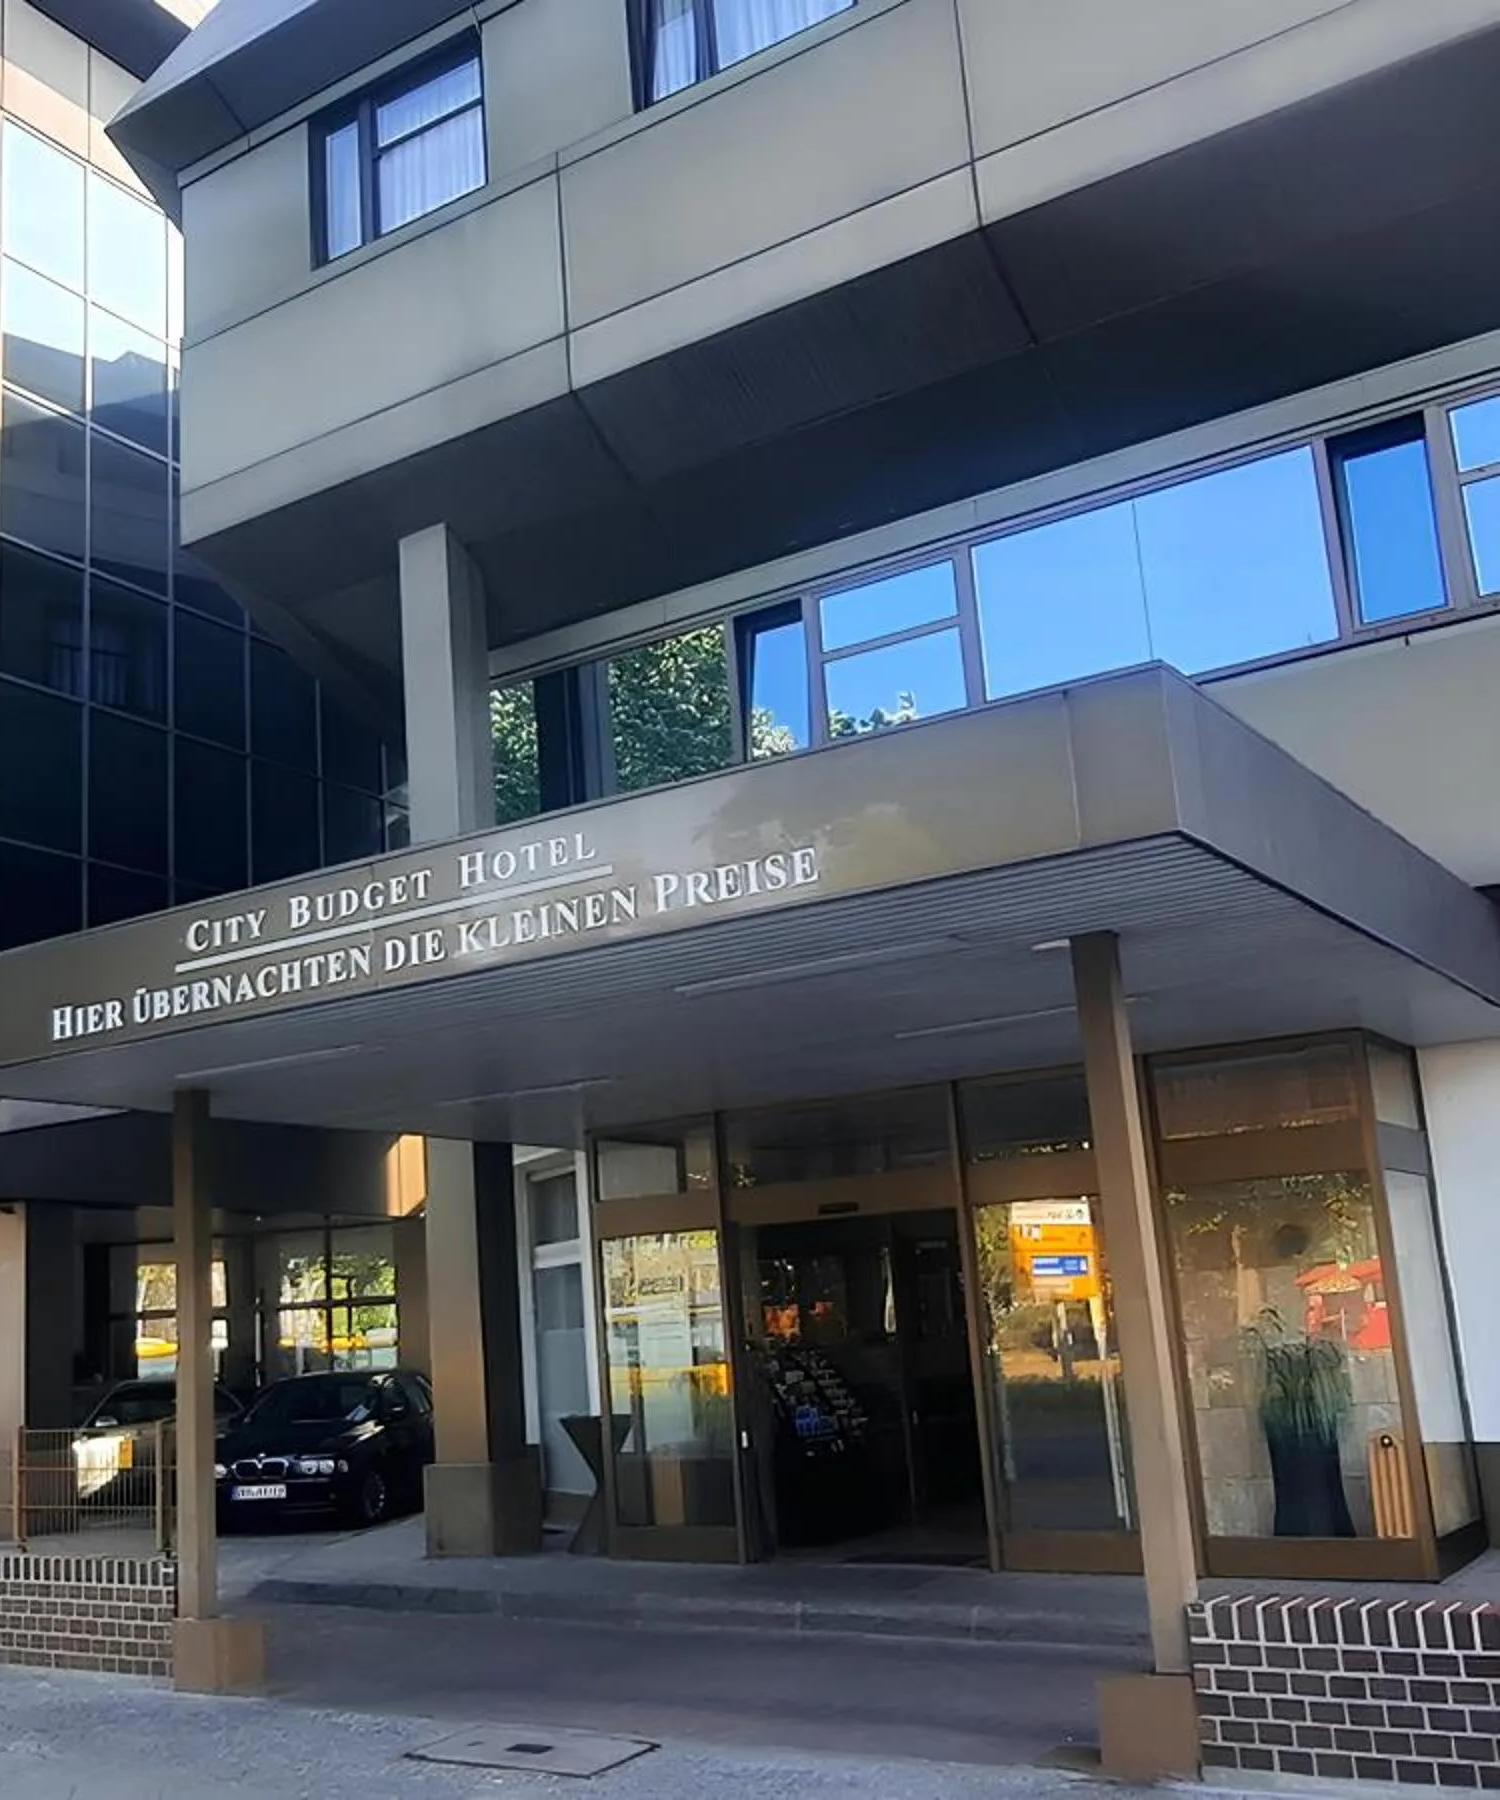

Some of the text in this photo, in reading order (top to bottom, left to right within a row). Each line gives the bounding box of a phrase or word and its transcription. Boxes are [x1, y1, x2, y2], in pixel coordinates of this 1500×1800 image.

[52, 847, 819, 1041] HIER ÜBERNACHTEN DIE KLEINEN PREISE
[186, 833, 595, 952] CITY BUDGET HOTEL
